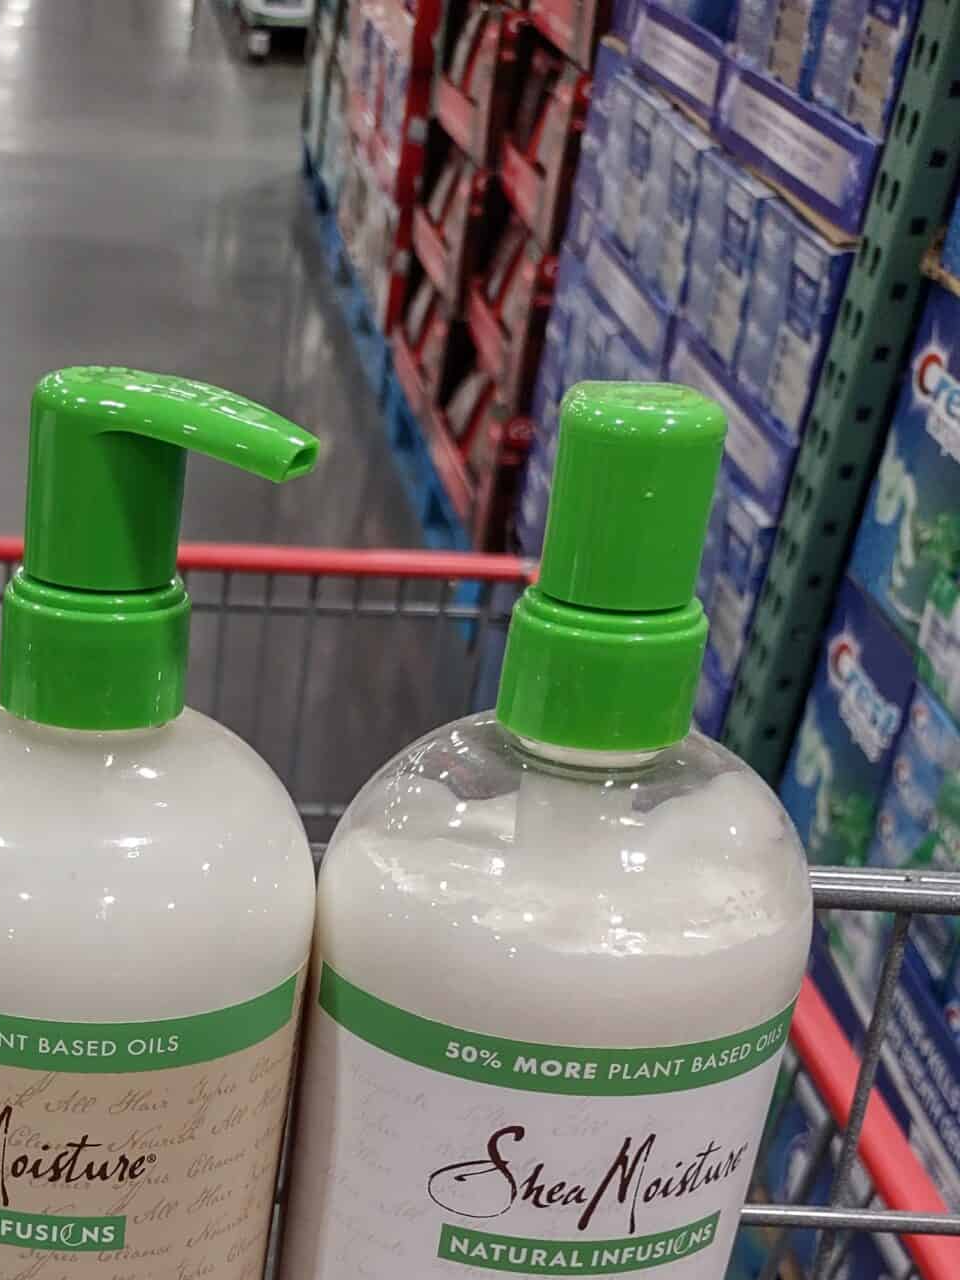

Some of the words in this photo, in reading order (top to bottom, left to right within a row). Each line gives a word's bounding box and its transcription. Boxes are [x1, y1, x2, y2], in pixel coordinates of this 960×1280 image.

[918, 353, 960, 419] Cre
[38, 1038, 117, 1057] BASED
[127, 1035, 180, 1056] OILS
[445, 1041, 502, 1069] 50%
[513, 1055, 597, 1080] MORE
[607, 1059, 684, 1080] PLANT
[691, 1043, 752, 1074] BASED
[755, 1023, 784, 1053] OILS
[449, 1236, 583, 1268] NATURAL
